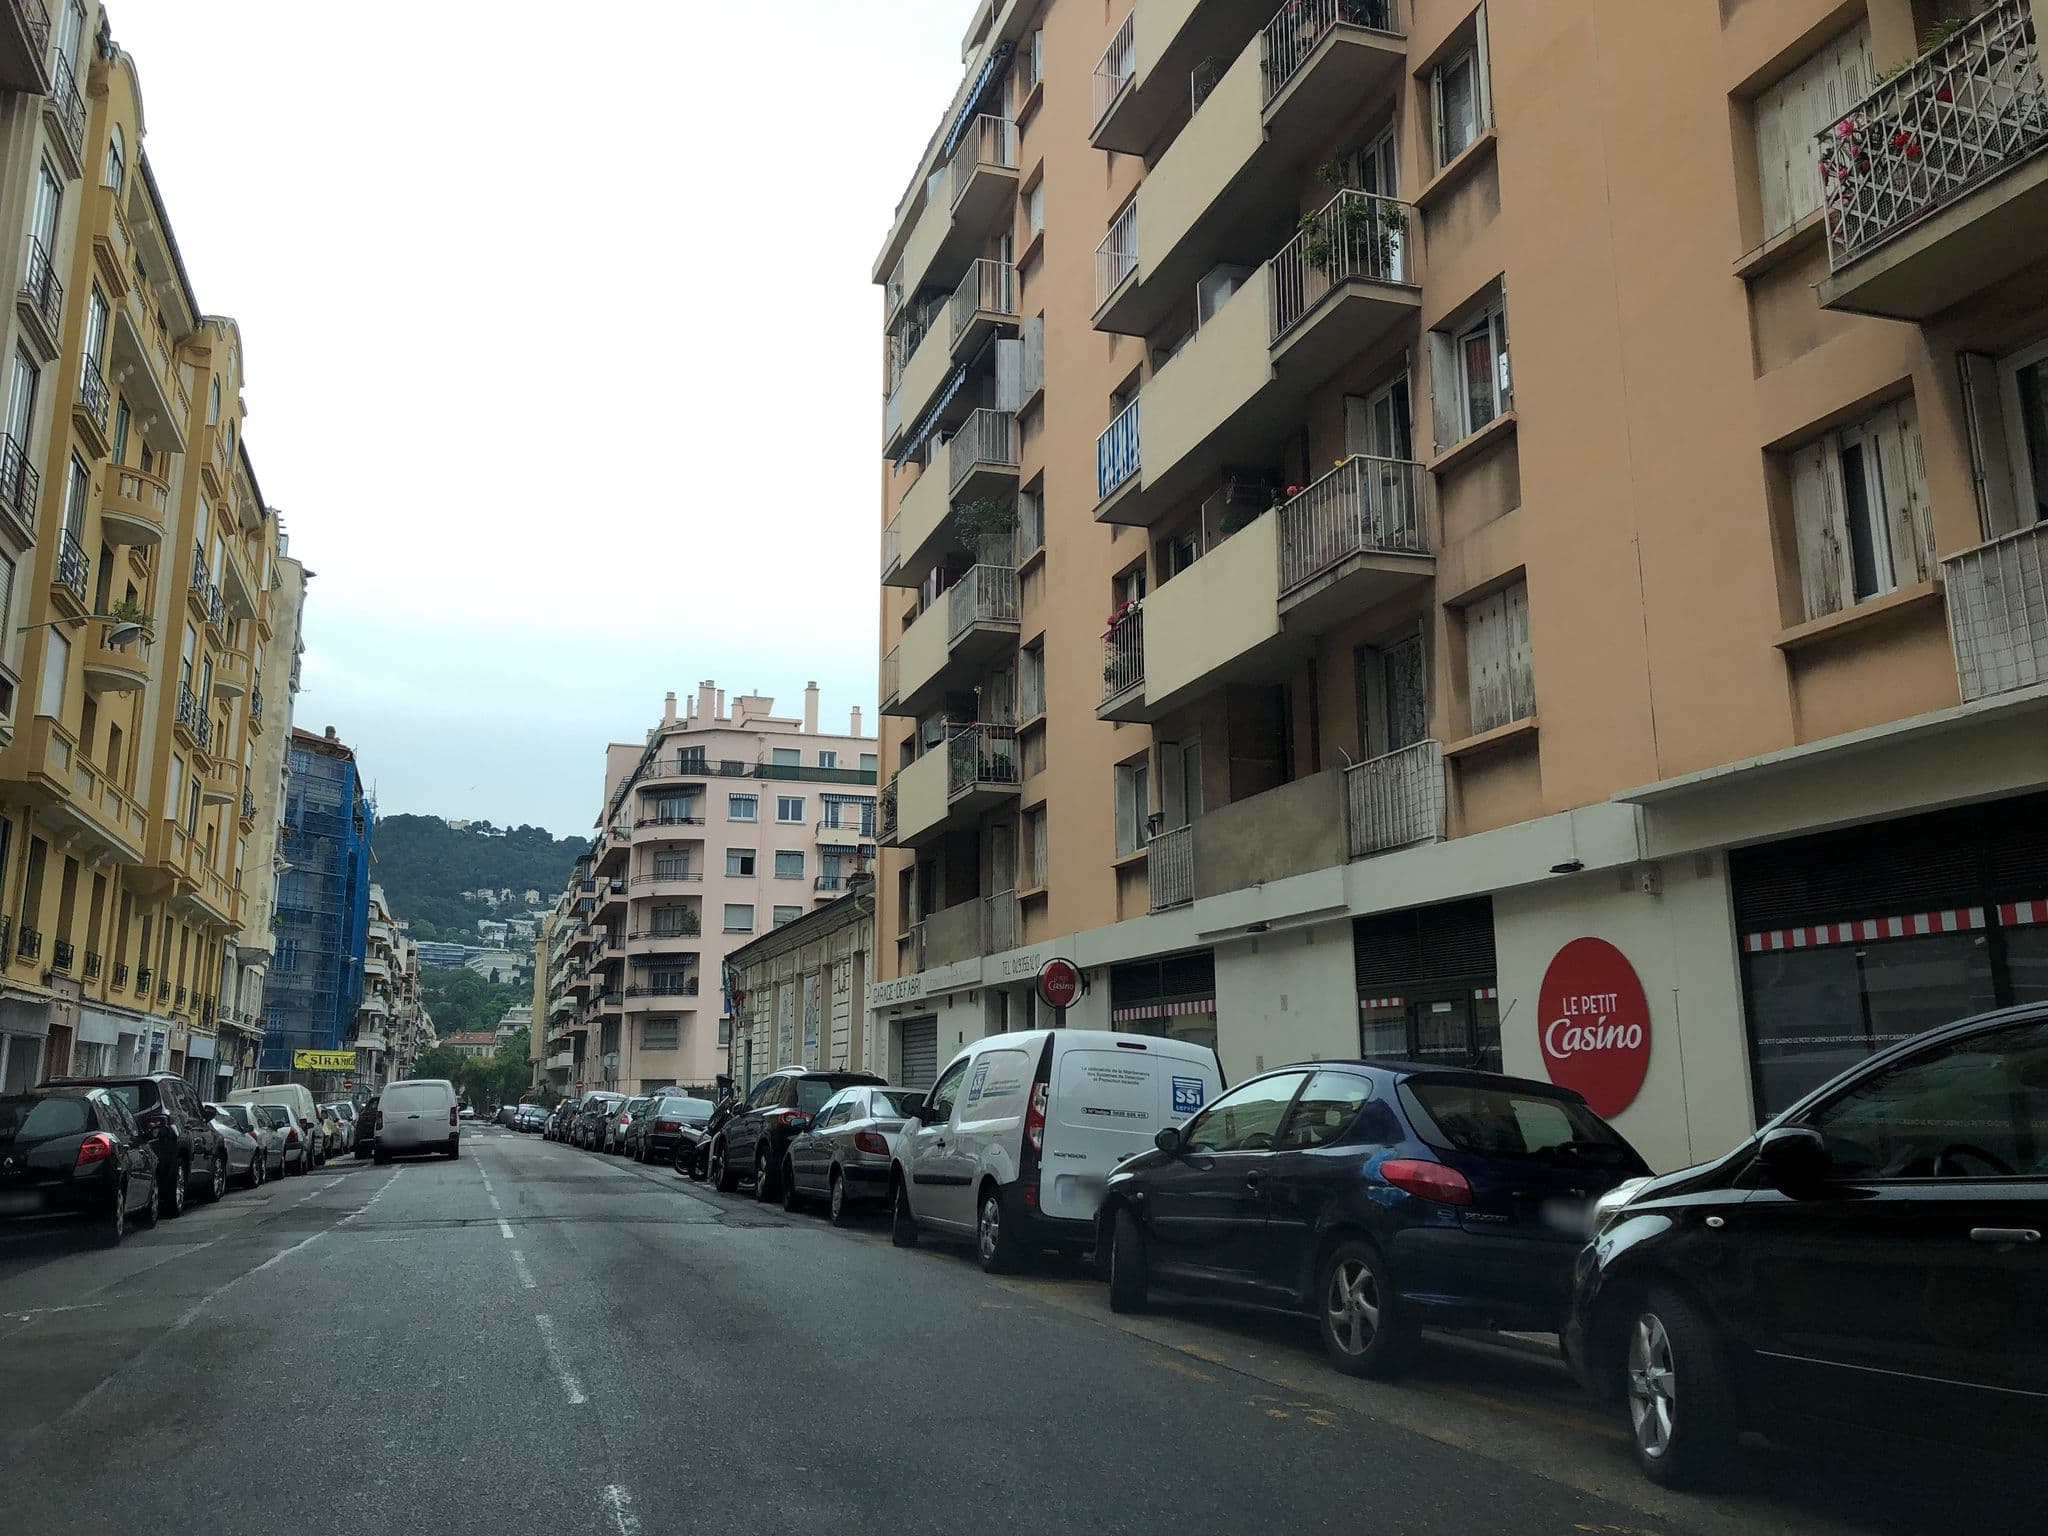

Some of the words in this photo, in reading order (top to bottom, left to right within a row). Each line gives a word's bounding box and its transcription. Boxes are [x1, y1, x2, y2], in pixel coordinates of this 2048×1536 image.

[873, 984, 894, 1003] GARAGE
[1048, 980, 1074, 991] Casino
[1562, 996, 1579, 1016] LE
[1581, 993, 1617, 1014] PETIT
[1545, 1016, 1642, 1059] Casino
